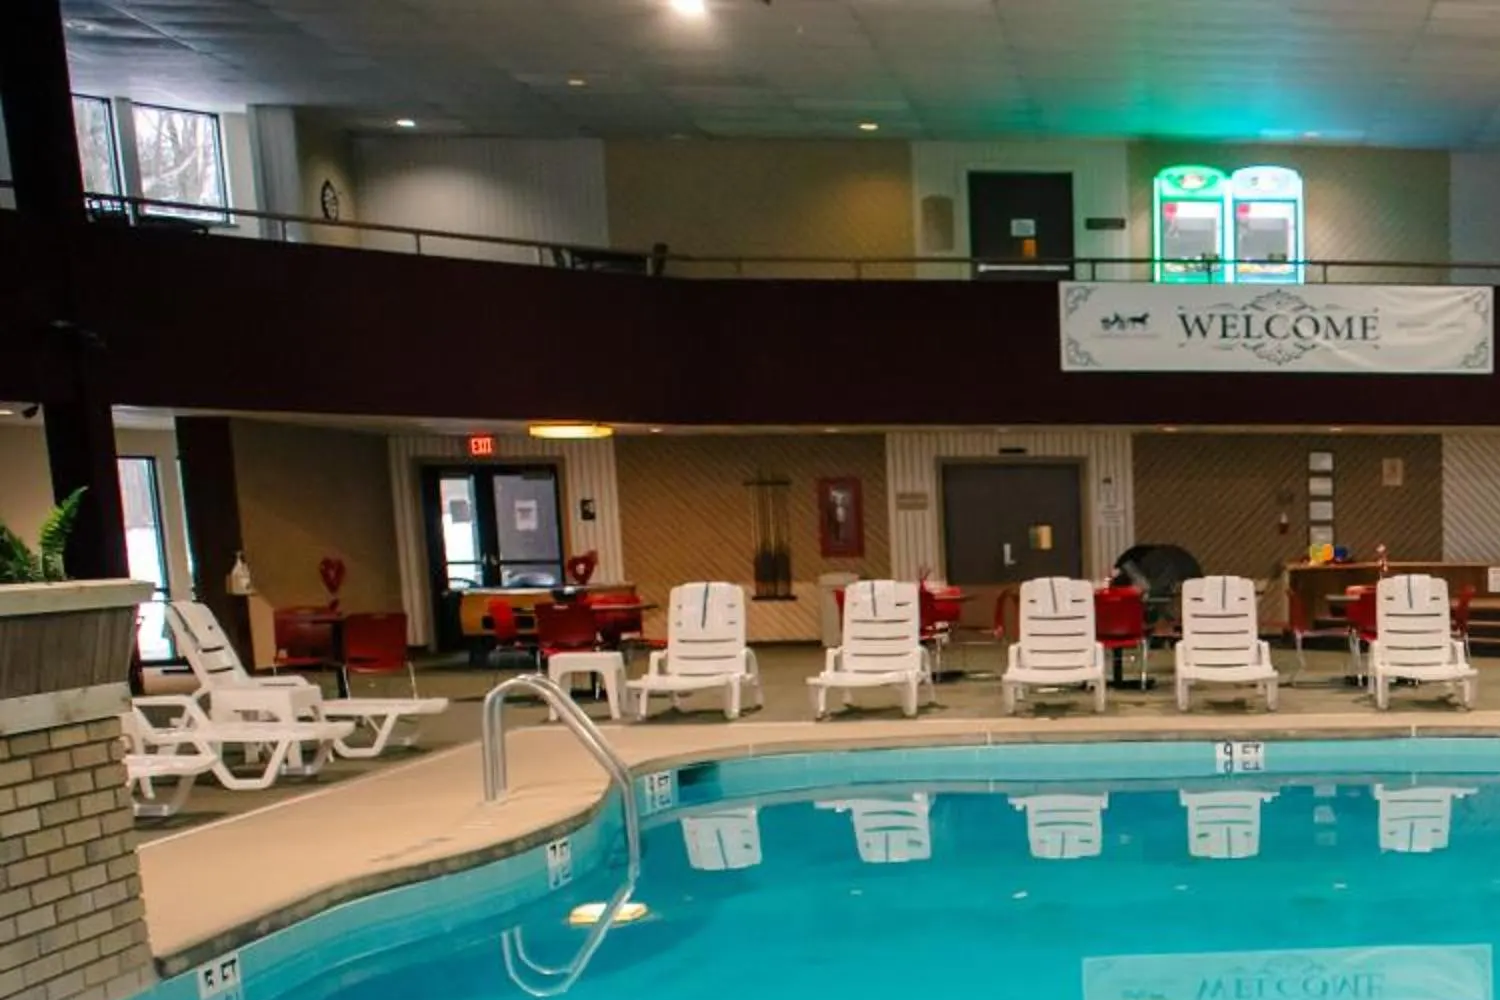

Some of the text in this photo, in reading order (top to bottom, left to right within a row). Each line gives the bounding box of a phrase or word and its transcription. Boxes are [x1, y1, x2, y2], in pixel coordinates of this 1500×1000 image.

[1177, 312, 1381, 341] WELCOME
[471, 437, 492, 455] EXIT
[1223, 741, 1260, 760] 9 FT
